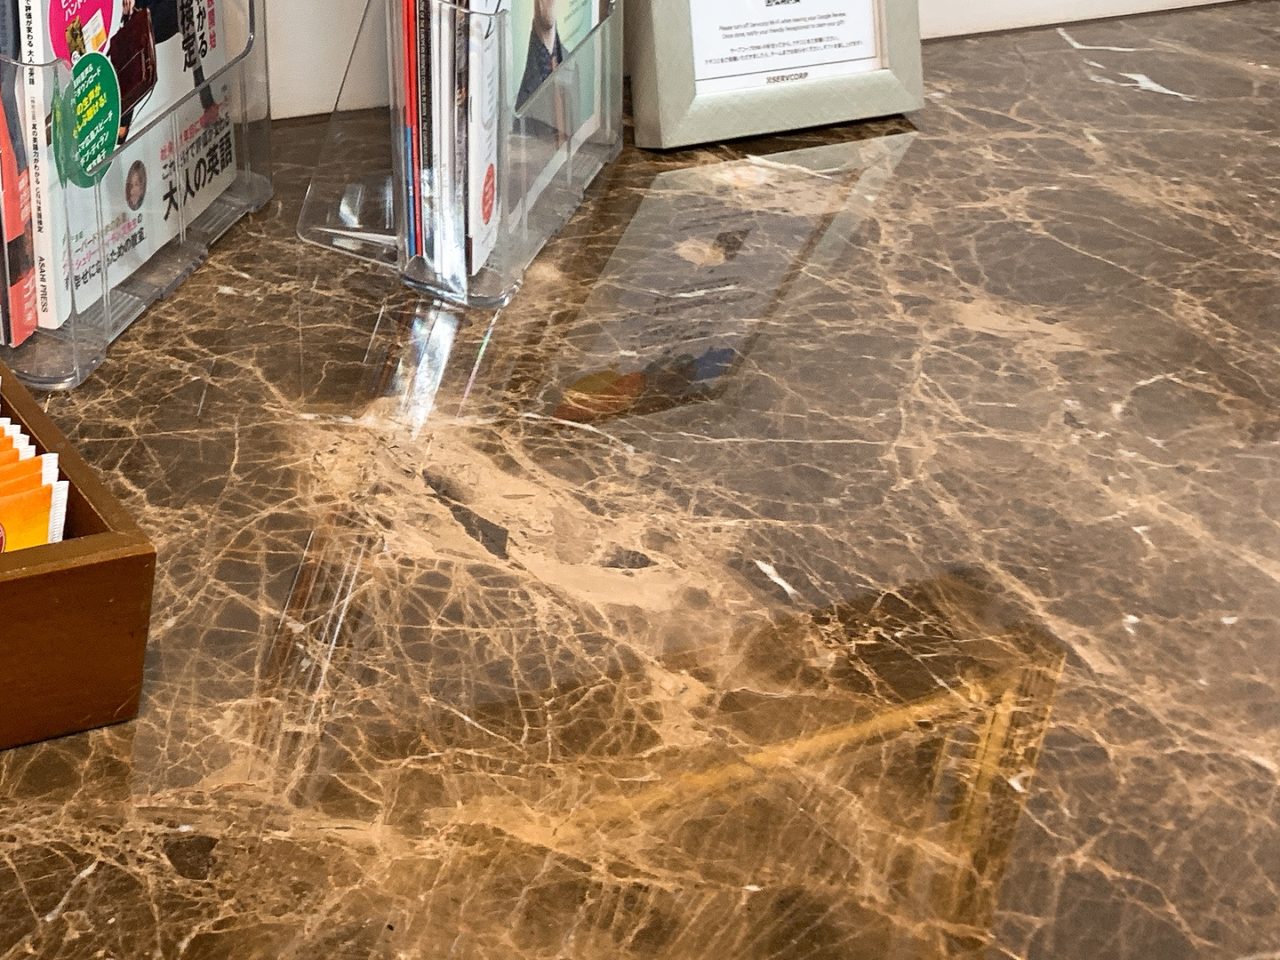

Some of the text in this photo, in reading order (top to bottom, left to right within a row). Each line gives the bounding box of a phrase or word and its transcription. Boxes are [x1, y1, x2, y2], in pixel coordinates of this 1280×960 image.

[162, 130, 233, 222] 大人の英語
[38, 256, 49, 313] ASAHI PRESS
